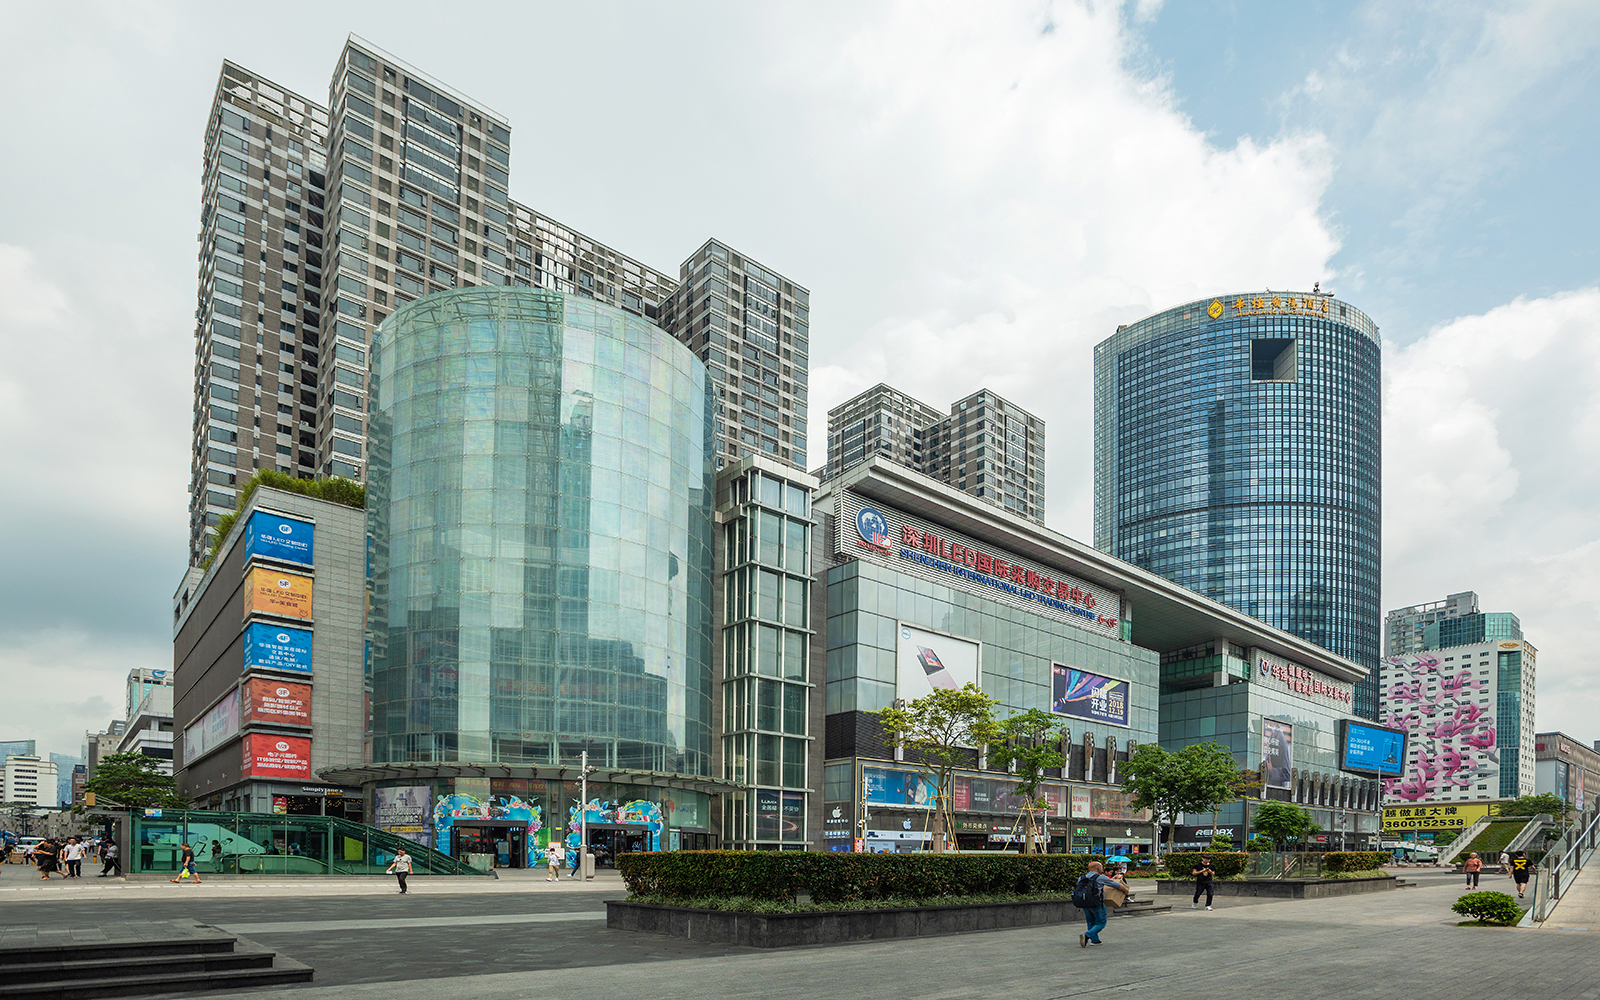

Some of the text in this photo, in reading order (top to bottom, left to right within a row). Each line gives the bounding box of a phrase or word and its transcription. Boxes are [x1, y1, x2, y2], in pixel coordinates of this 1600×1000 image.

[902, 524, 1097, 608] 深圳LED国际采购交易中心
[900, 547, 953, 574] SHENZHEN
[953, 565, 1020, 596] INTERNATIONAL
[1020, 588, 1036, 600] LED
[1036, 593, 1069, 612] TRADING
[1067, 605, 1095, 621] CENTRE
[1108, 699, 1124, 710] 2018
[1384, 806, 1458, 817] 越做越大牌
[1381, 818, 1464, 828] 13600152538
